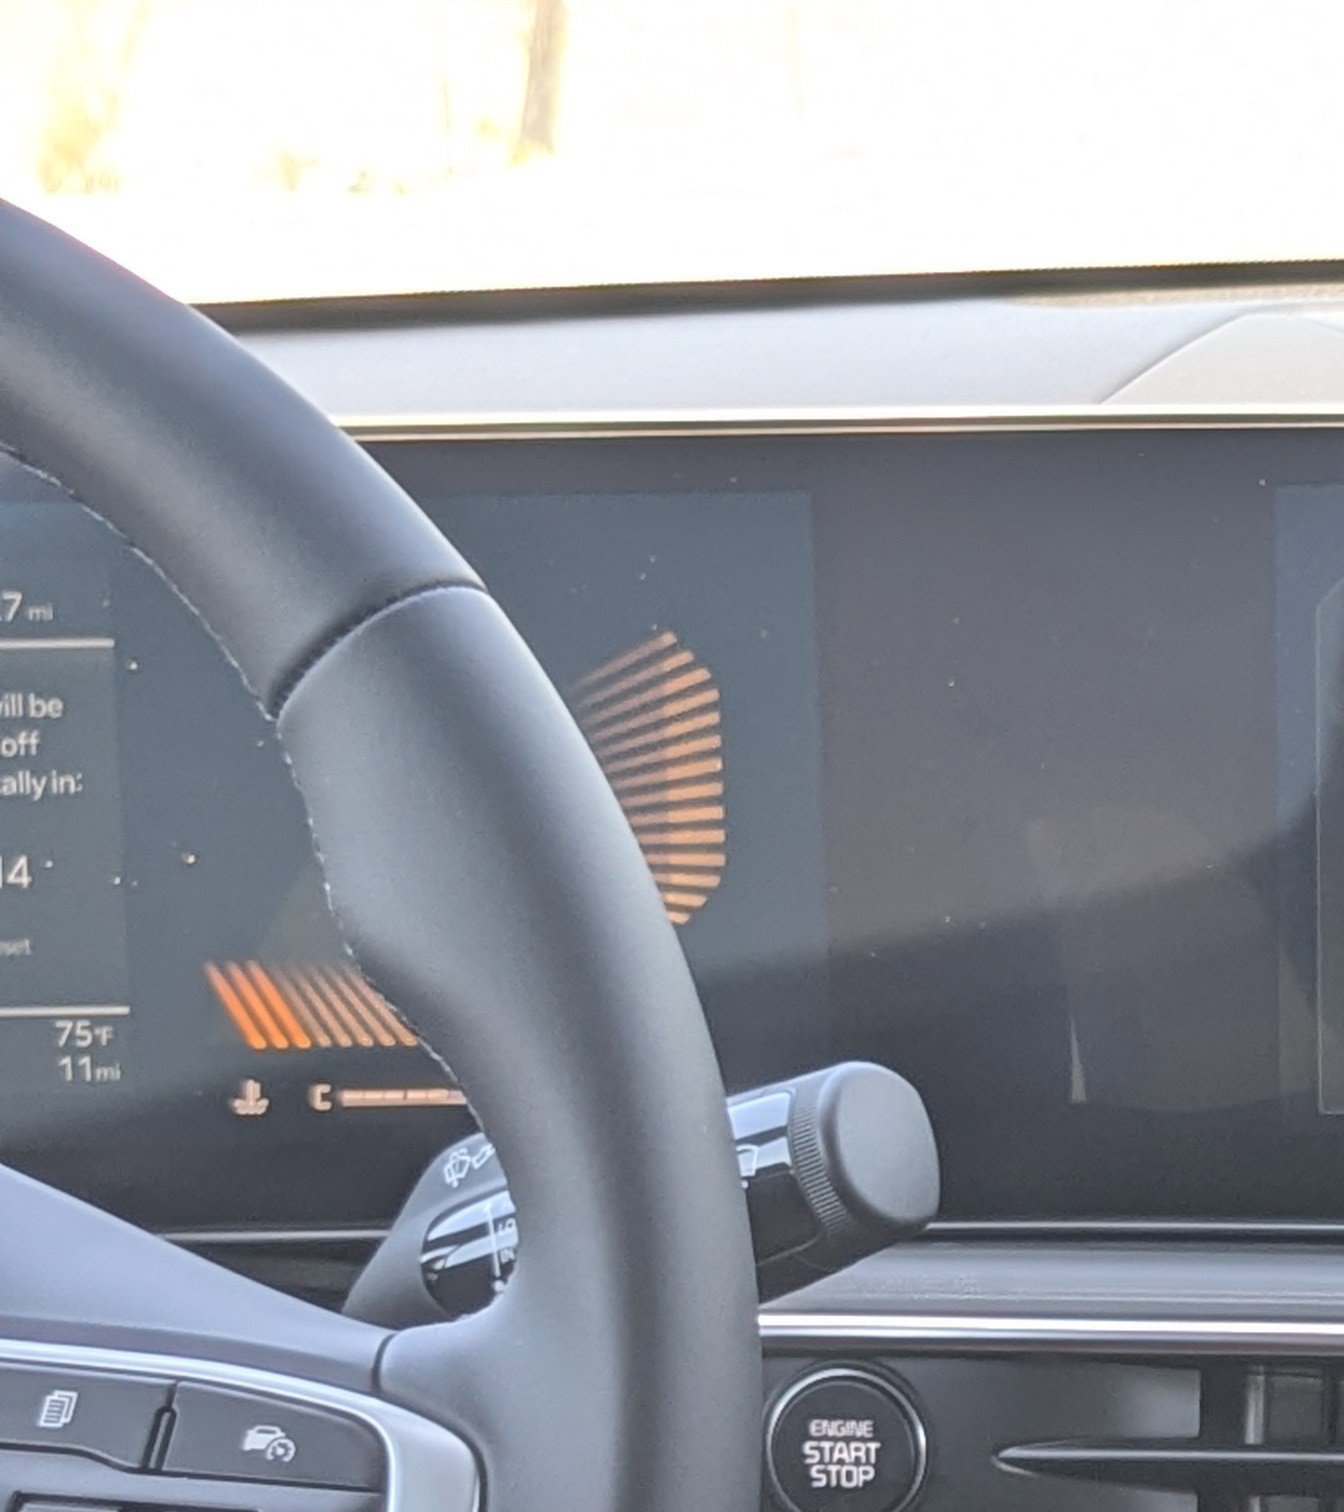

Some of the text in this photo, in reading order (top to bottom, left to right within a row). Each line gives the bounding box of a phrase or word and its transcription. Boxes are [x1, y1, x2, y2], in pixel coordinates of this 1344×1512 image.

[28, 692, 64, 718] be
[809, 1419, 874, 1438] ENGINE
[802, 1441, 881, 1464] START
[809, 1464, 875, 1488] STOP
